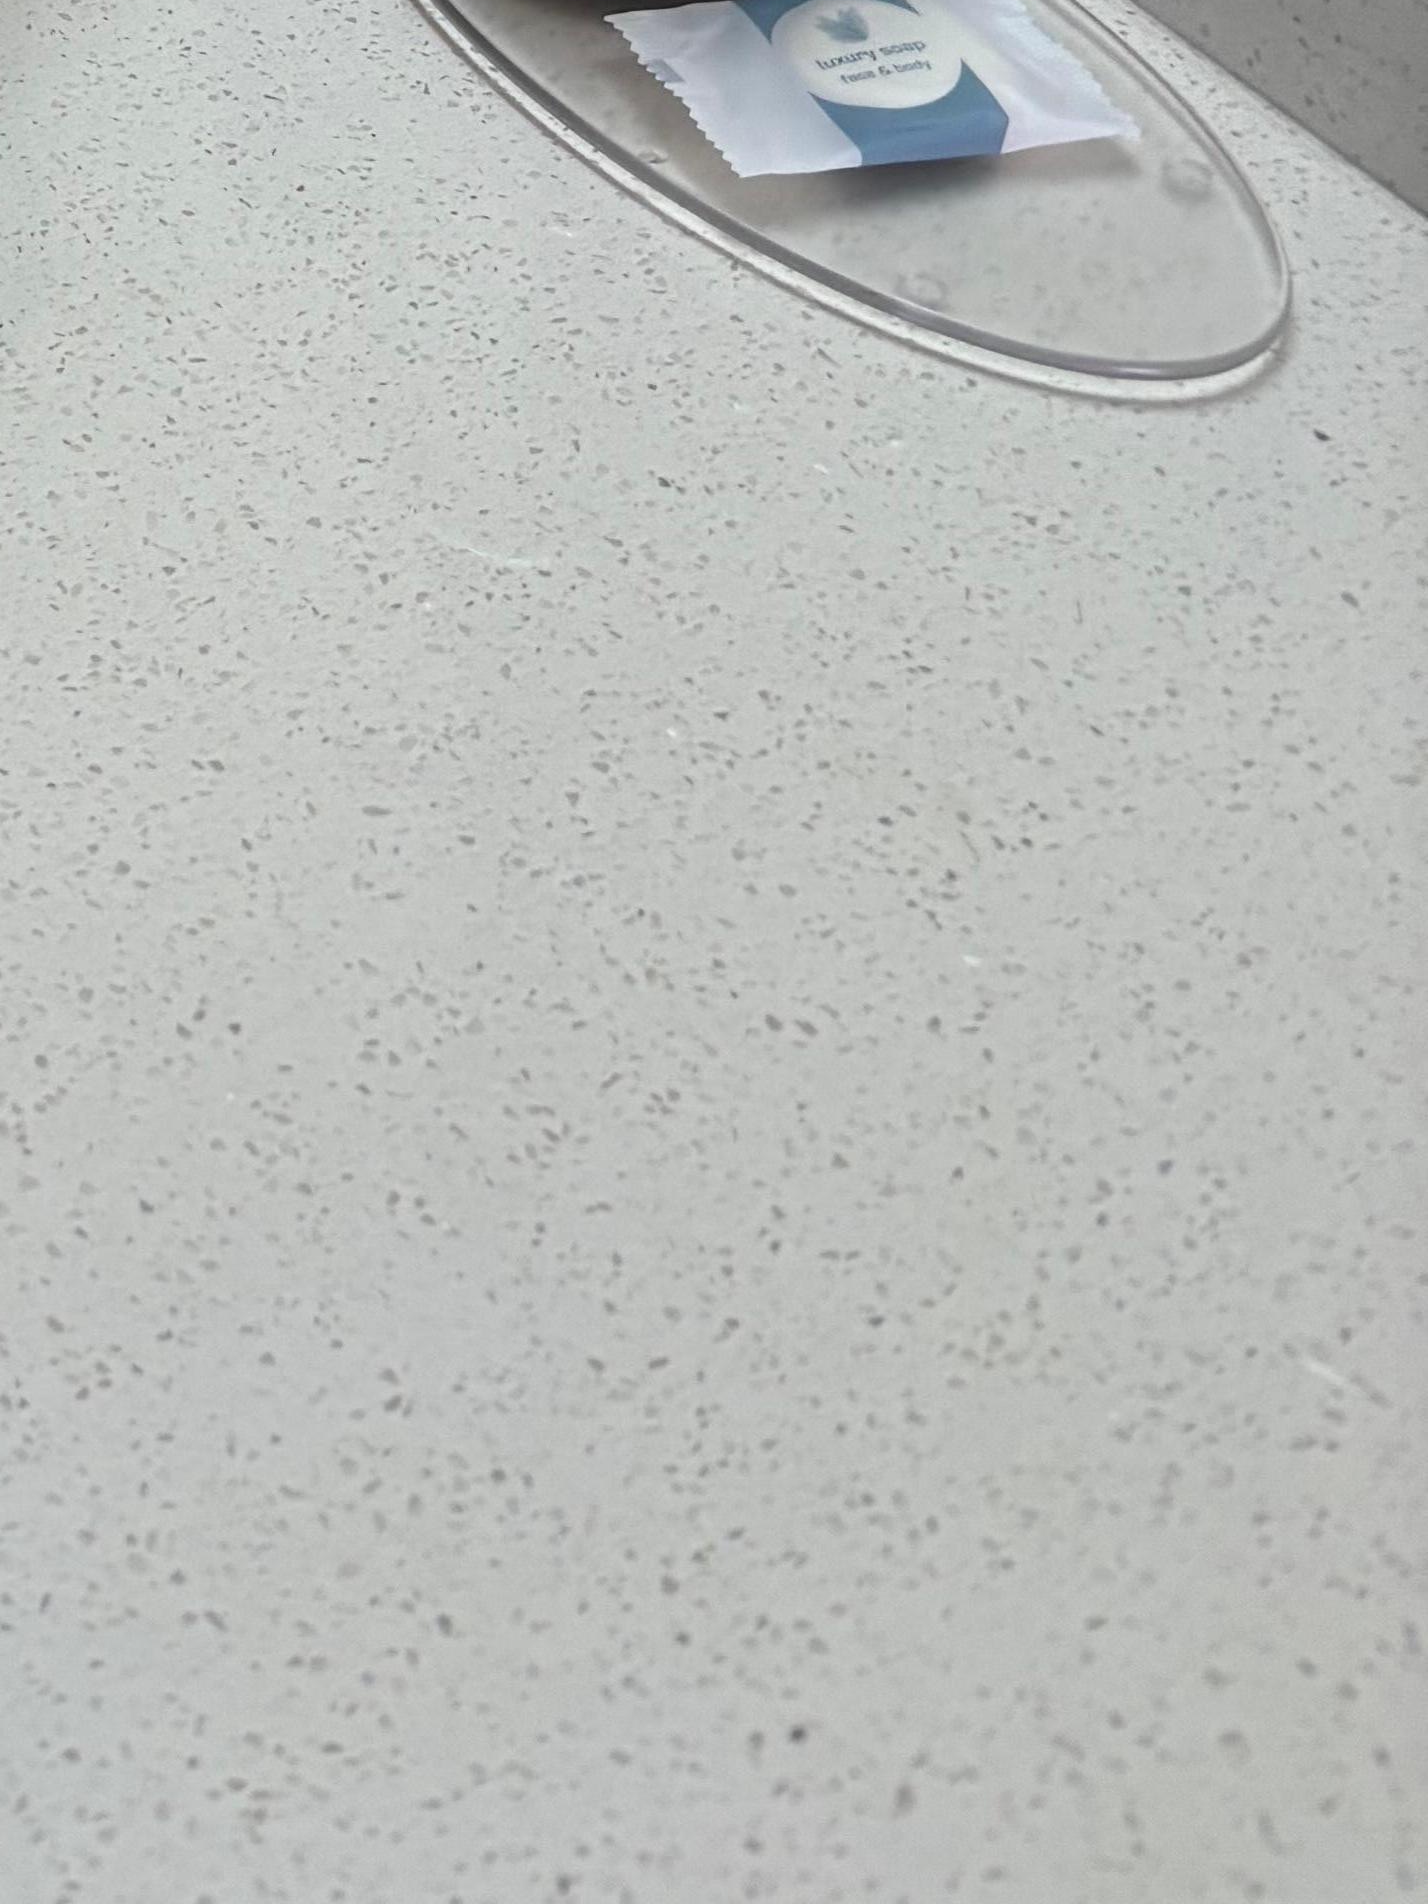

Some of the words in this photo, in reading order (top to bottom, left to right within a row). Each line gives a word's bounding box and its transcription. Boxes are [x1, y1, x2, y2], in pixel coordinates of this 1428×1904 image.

[814, 49, 877, 71] luxury
[878, 39, 926, 57] soap
[877, 65, 892, 77] &
[892, 59, 932, 73] body
